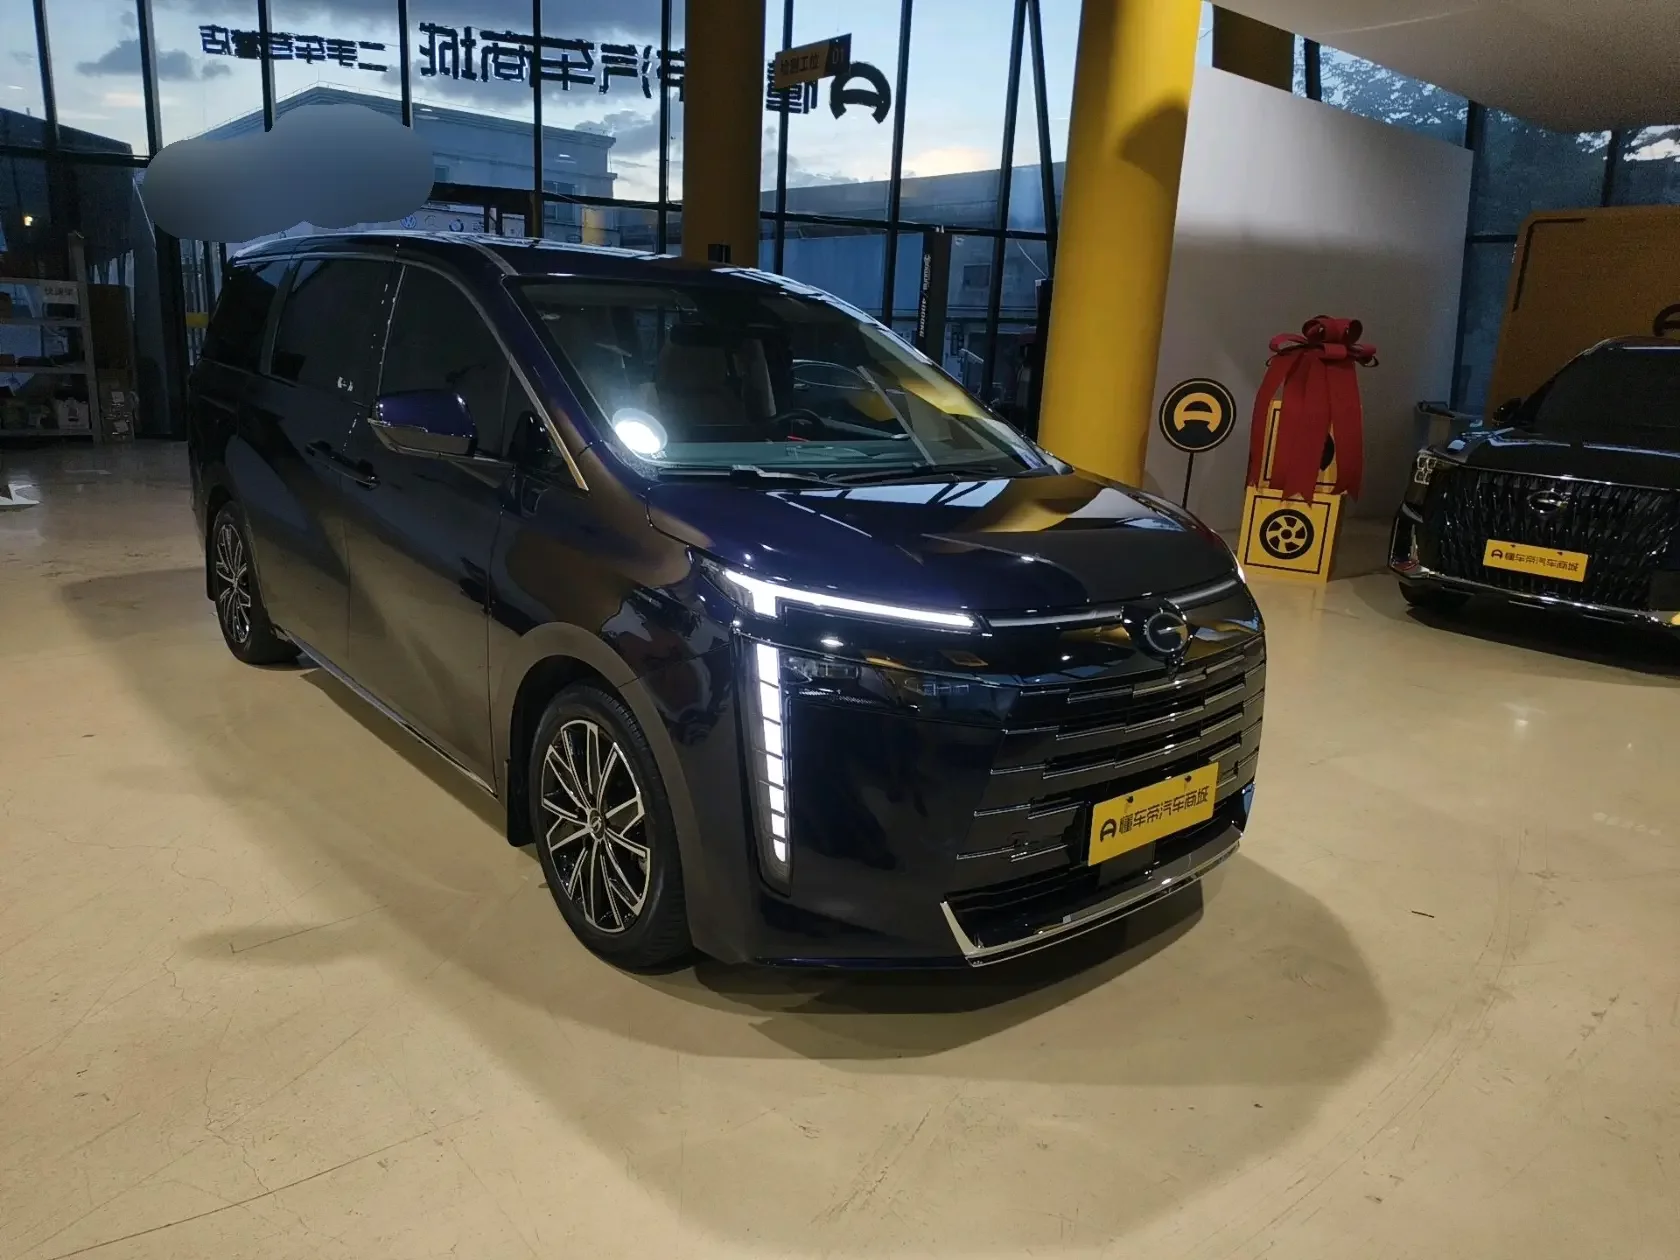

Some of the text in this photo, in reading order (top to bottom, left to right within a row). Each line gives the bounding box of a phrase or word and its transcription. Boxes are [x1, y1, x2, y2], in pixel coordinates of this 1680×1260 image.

[1505, 552, 1579, 571] 懂车帝汽车商城
[1119, 785, 1209, 833] 懂车帝汽车商城
